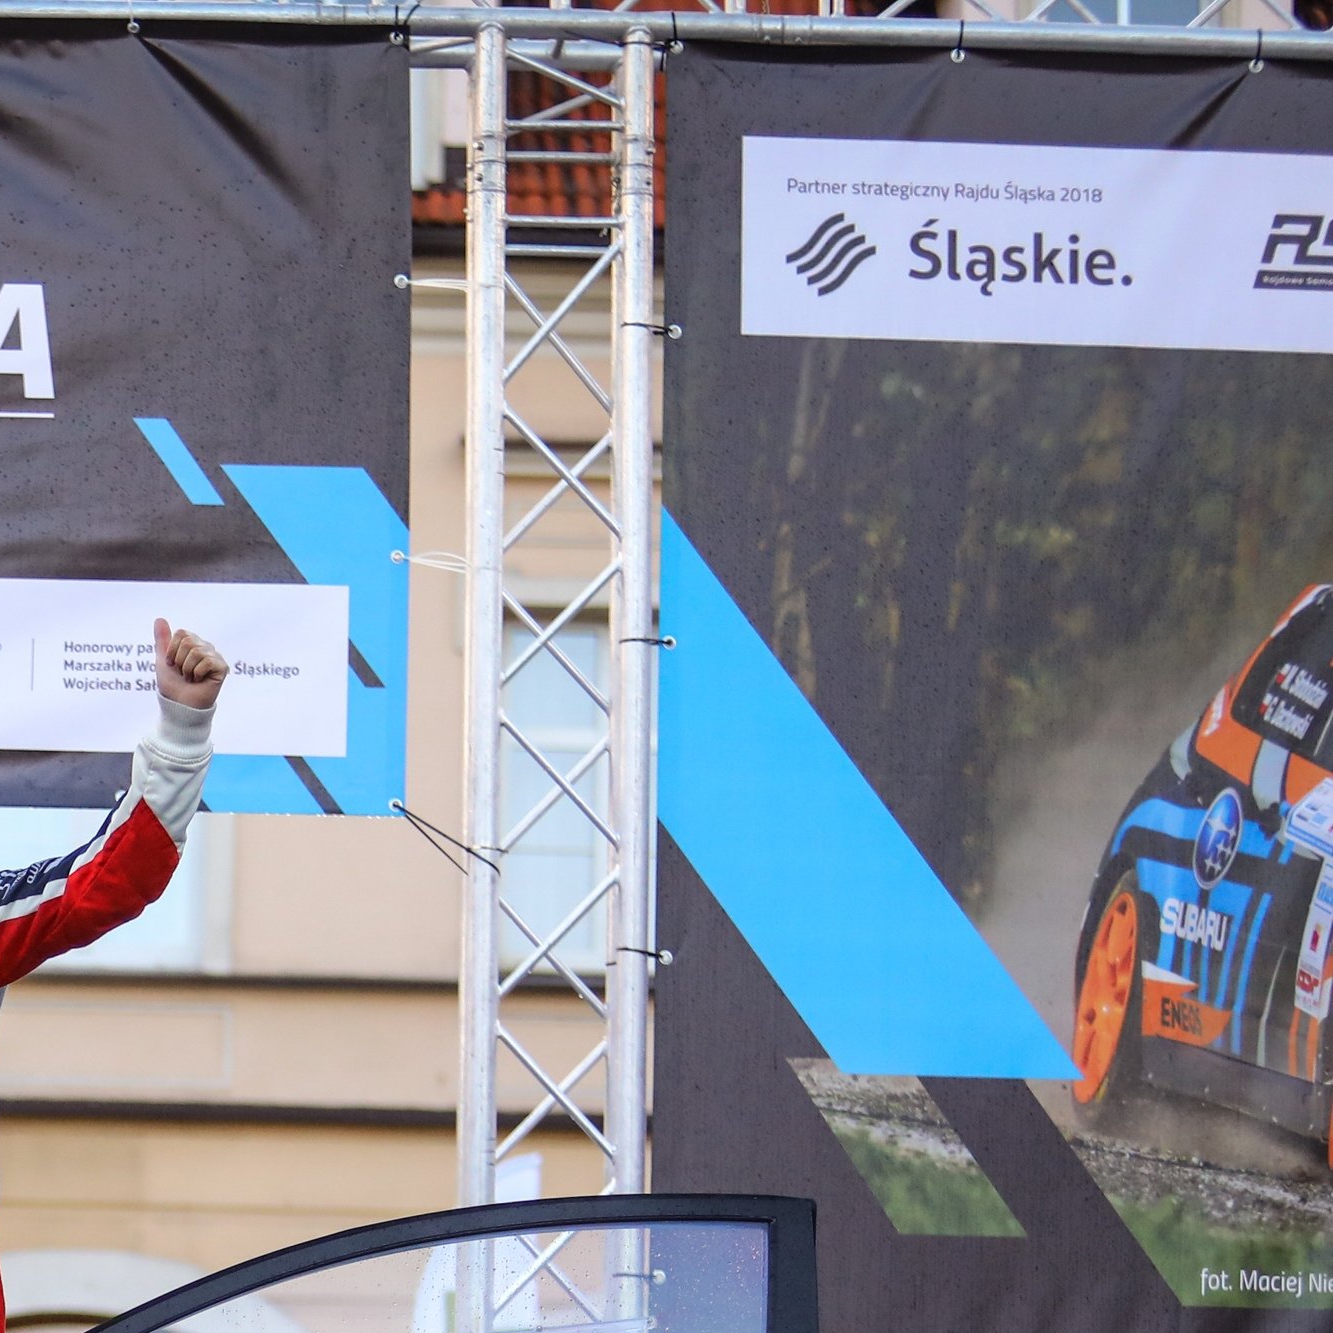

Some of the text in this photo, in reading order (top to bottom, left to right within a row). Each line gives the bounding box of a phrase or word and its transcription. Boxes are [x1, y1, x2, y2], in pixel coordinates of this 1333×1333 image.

[786, 178, 1103, 205] Partner strategiczny Rajdu Śląska 2018
[908, 218, 1133, 297] Śląskie.
[63, 641, 133, 654] Honorowy
[63, 660, 132, 672] Marszałka
[234, 660, 301, 680] Śląskiego
[63, 678, 132, 692] Wojciecha
[1160, 897, 1228, 952] SUBARU
[1200, 1267, 1233, 1292] fot.
[1239, 1269, 1302, 1297] Maciej
